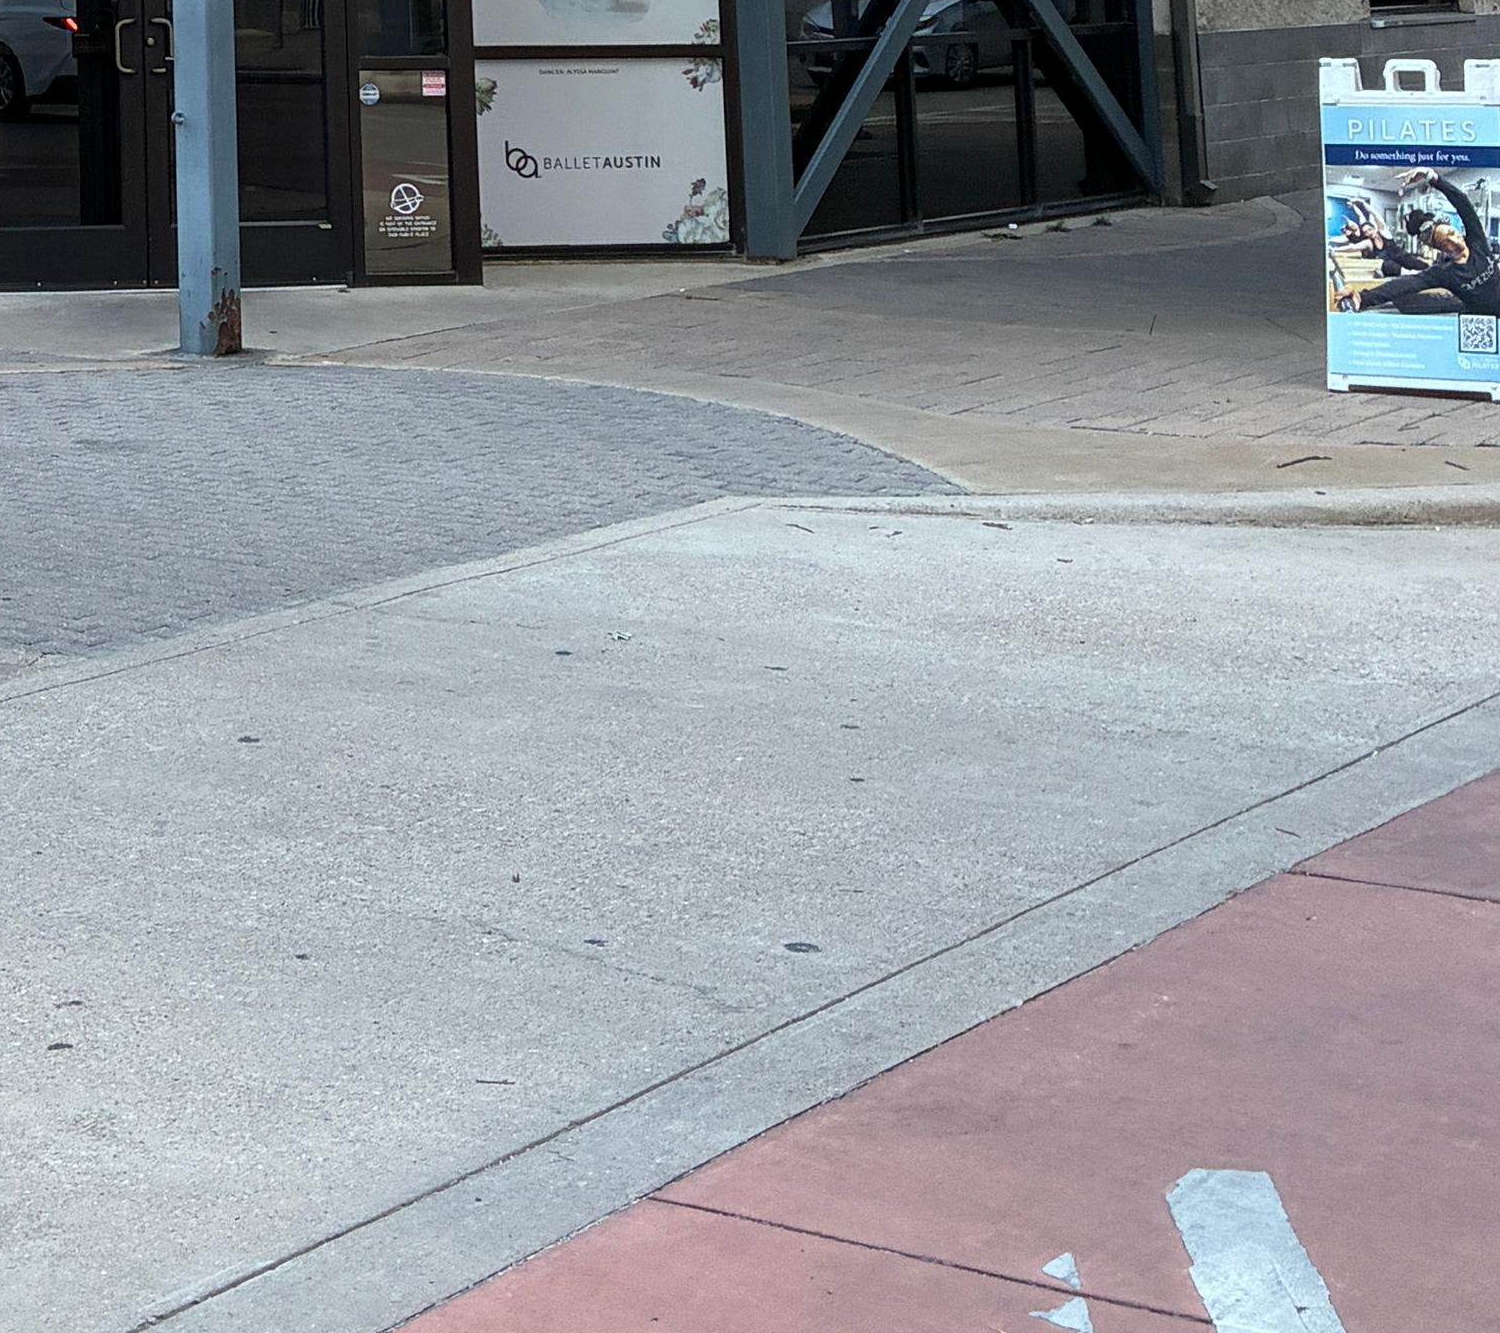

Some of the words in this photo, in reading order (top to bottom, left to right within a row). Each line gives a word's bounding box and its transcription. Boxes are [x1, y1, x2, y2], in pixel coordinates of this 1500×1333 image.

[1347, 118, 1477, 143] PILATES
[1355, 150, 1369, 160] Do
[1370, 150, 1416, 163] something
[1417, 152, 1434, 164] just
[1436, 151, 1450, 161] for
[1451, 154, 1471, 164] you.
